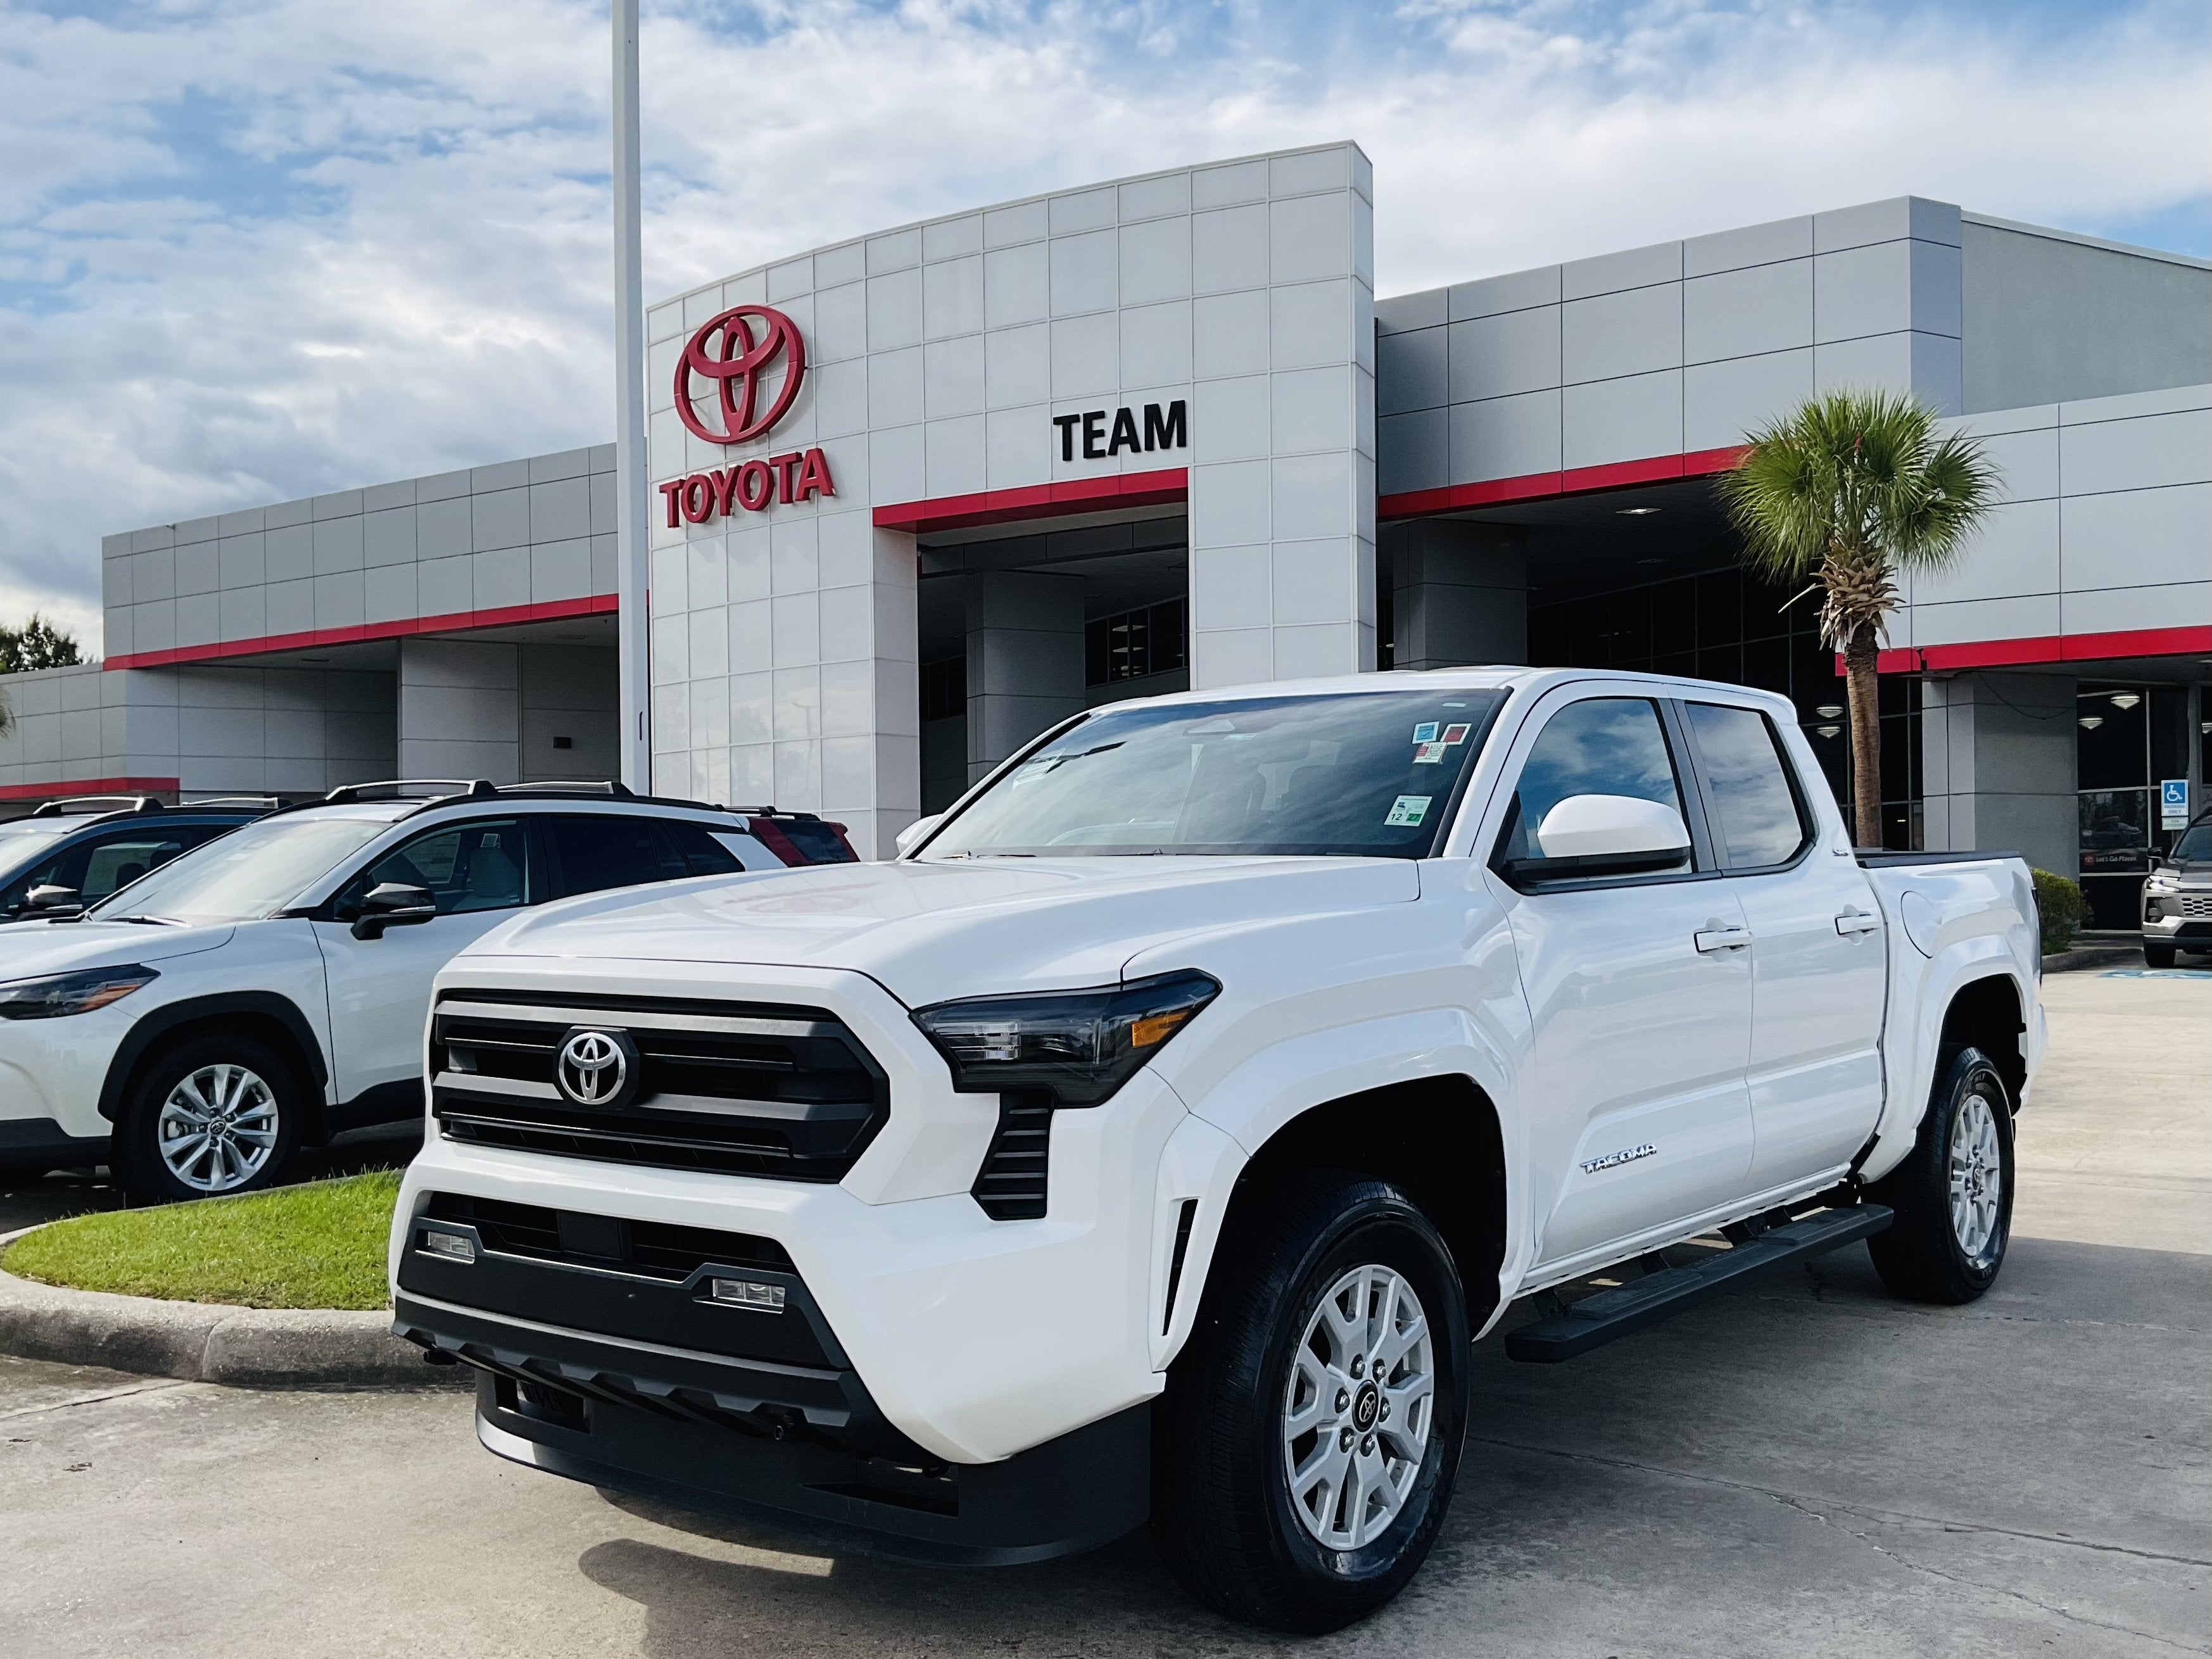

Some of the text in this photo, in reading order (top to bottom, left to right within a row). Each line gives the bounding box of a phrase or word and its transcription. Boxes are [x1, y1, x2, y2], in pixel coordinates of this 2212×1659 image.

[1053, 399, 1188, 462] TEAM
[659, 447, 837, 529] TOYOTA
[1580, 1143, 1657, 1174] TACOMA
